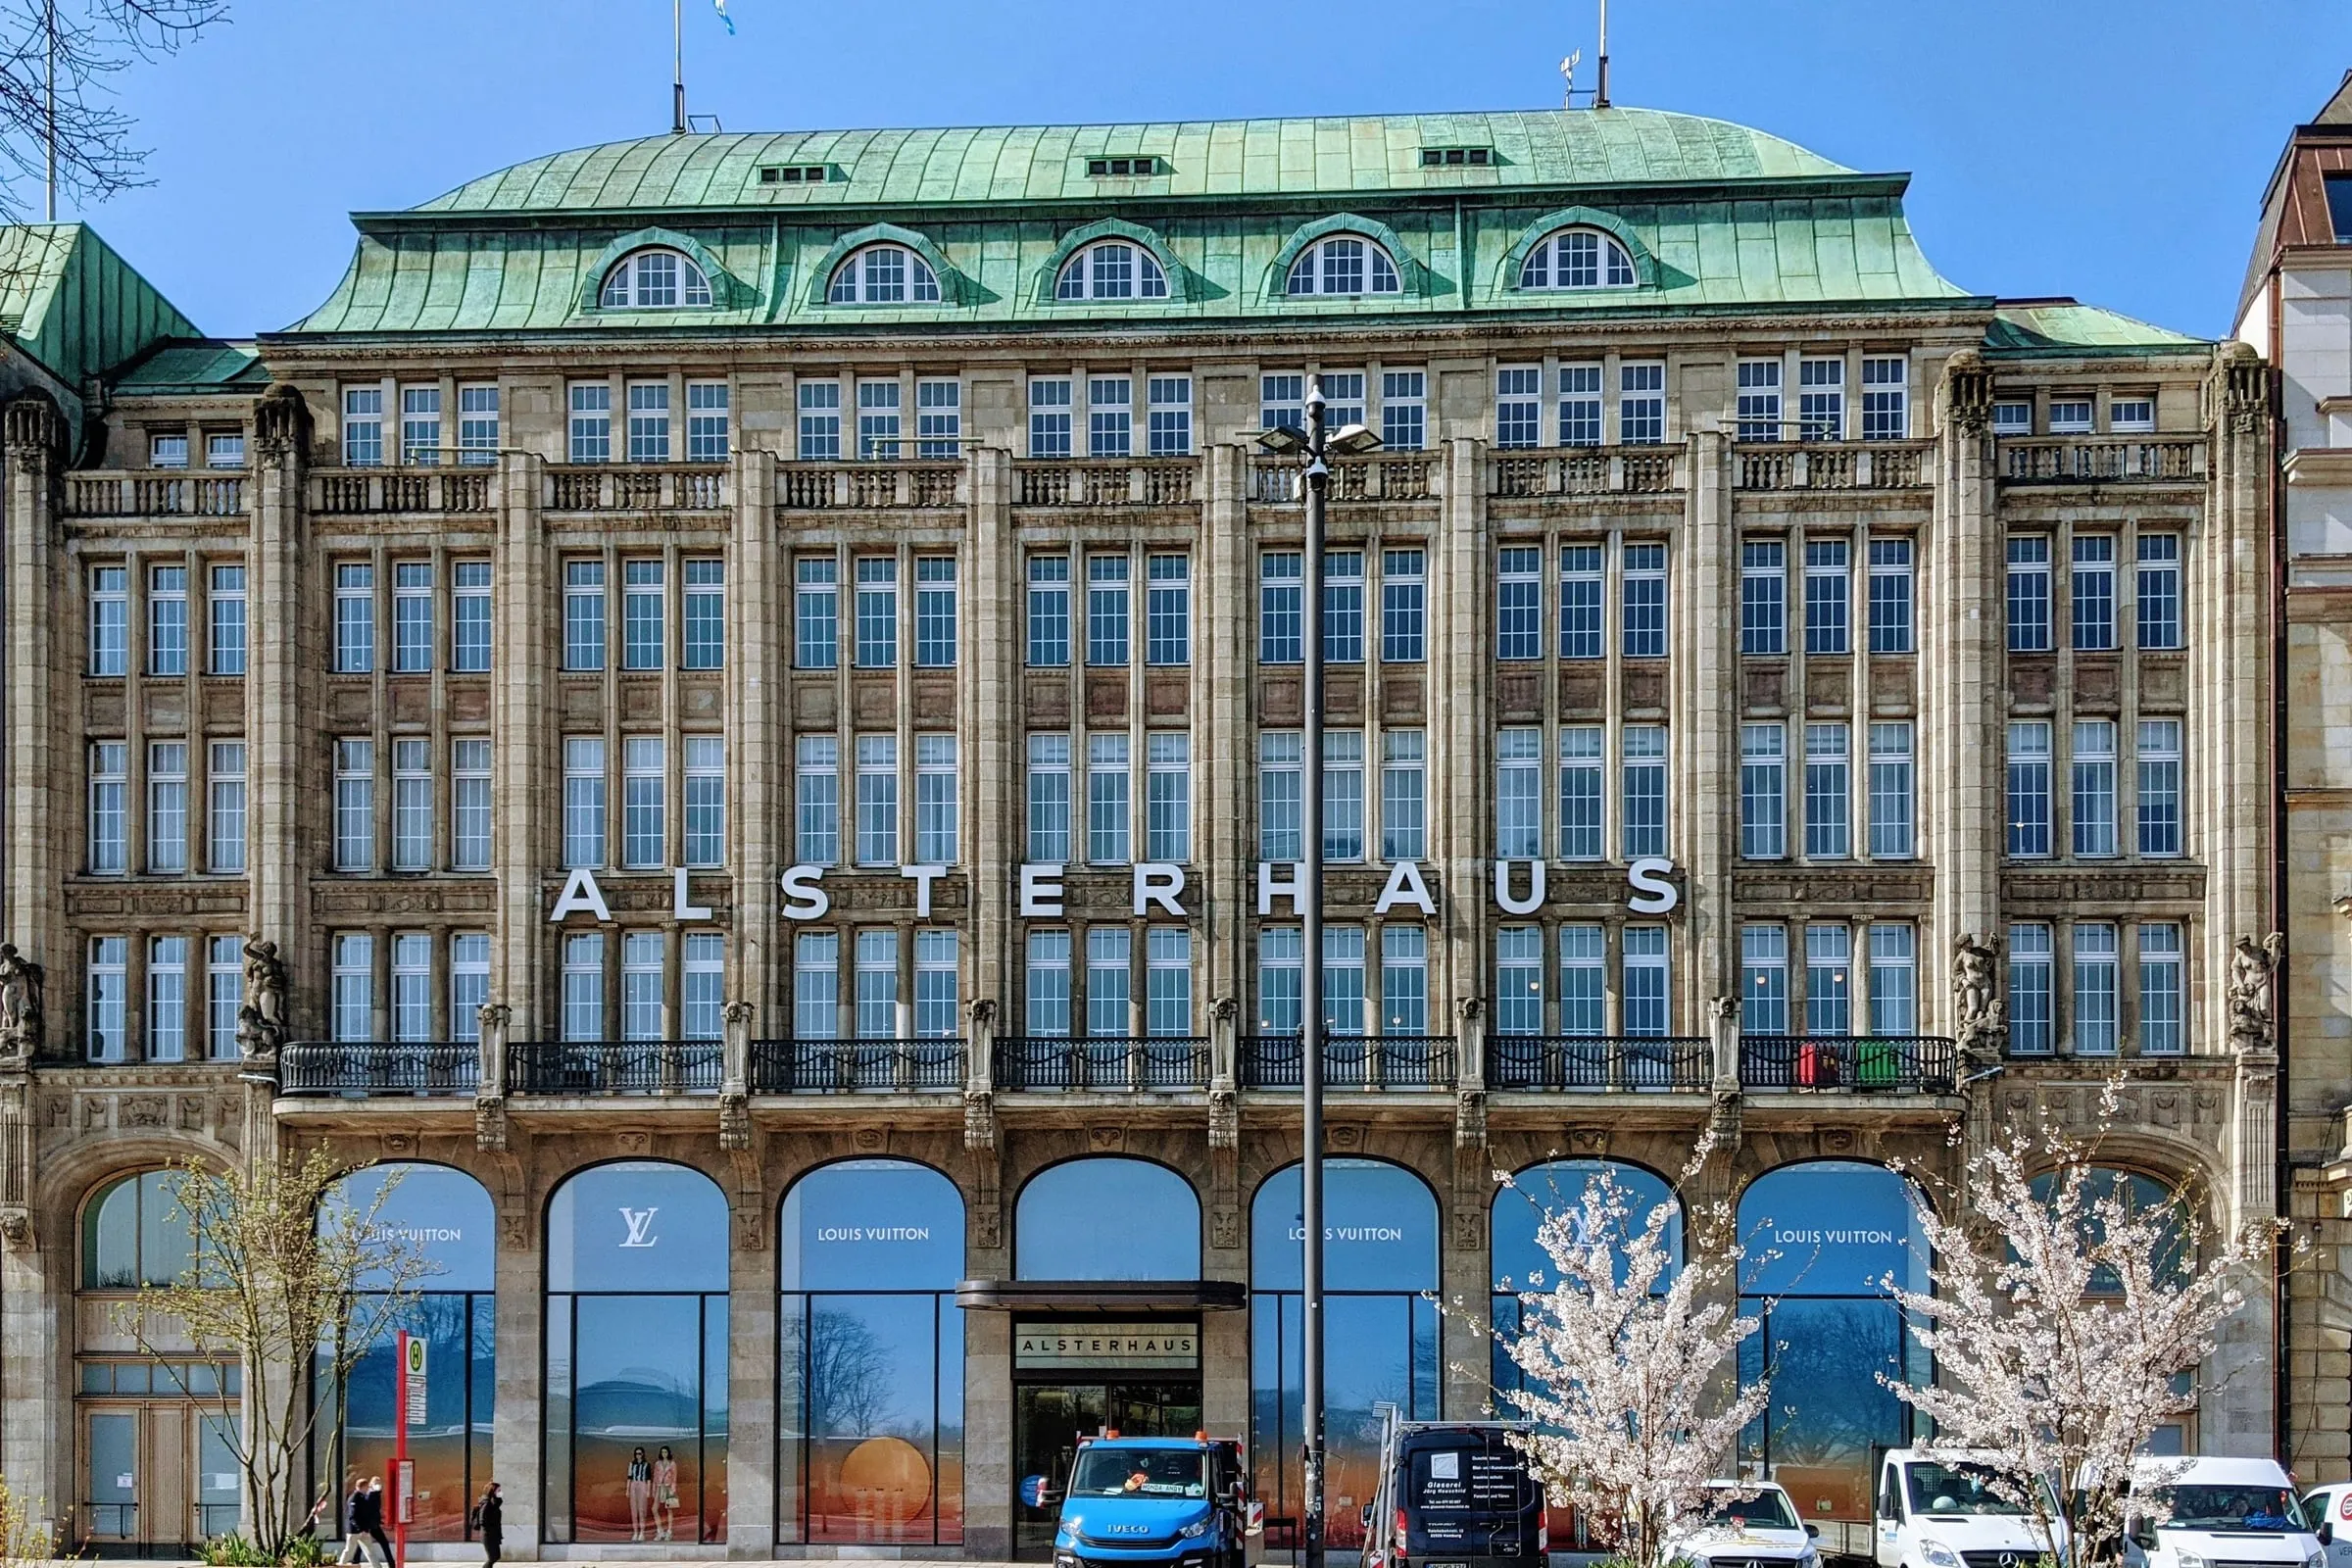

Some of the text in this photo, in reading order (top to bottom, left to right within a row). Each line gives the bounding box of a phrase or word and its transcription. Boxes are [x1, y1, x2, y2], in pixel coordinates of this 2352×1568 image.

[550, 858, 1678, 923] ALSTERHAUS
[398, 1228, 462, 1242] VUITTON
[817, 1227, 929, 1241] LOUIS VUITTON
[1289, 1227, 1401, 1241] LOS VUITTON
[1775, 1230, 1892, 1244] LOUIS VUITTON
[1022, 1340, 1192, 1351] ALSTERHAUS
[1107, 1524, 1150, 1534] IVECO
